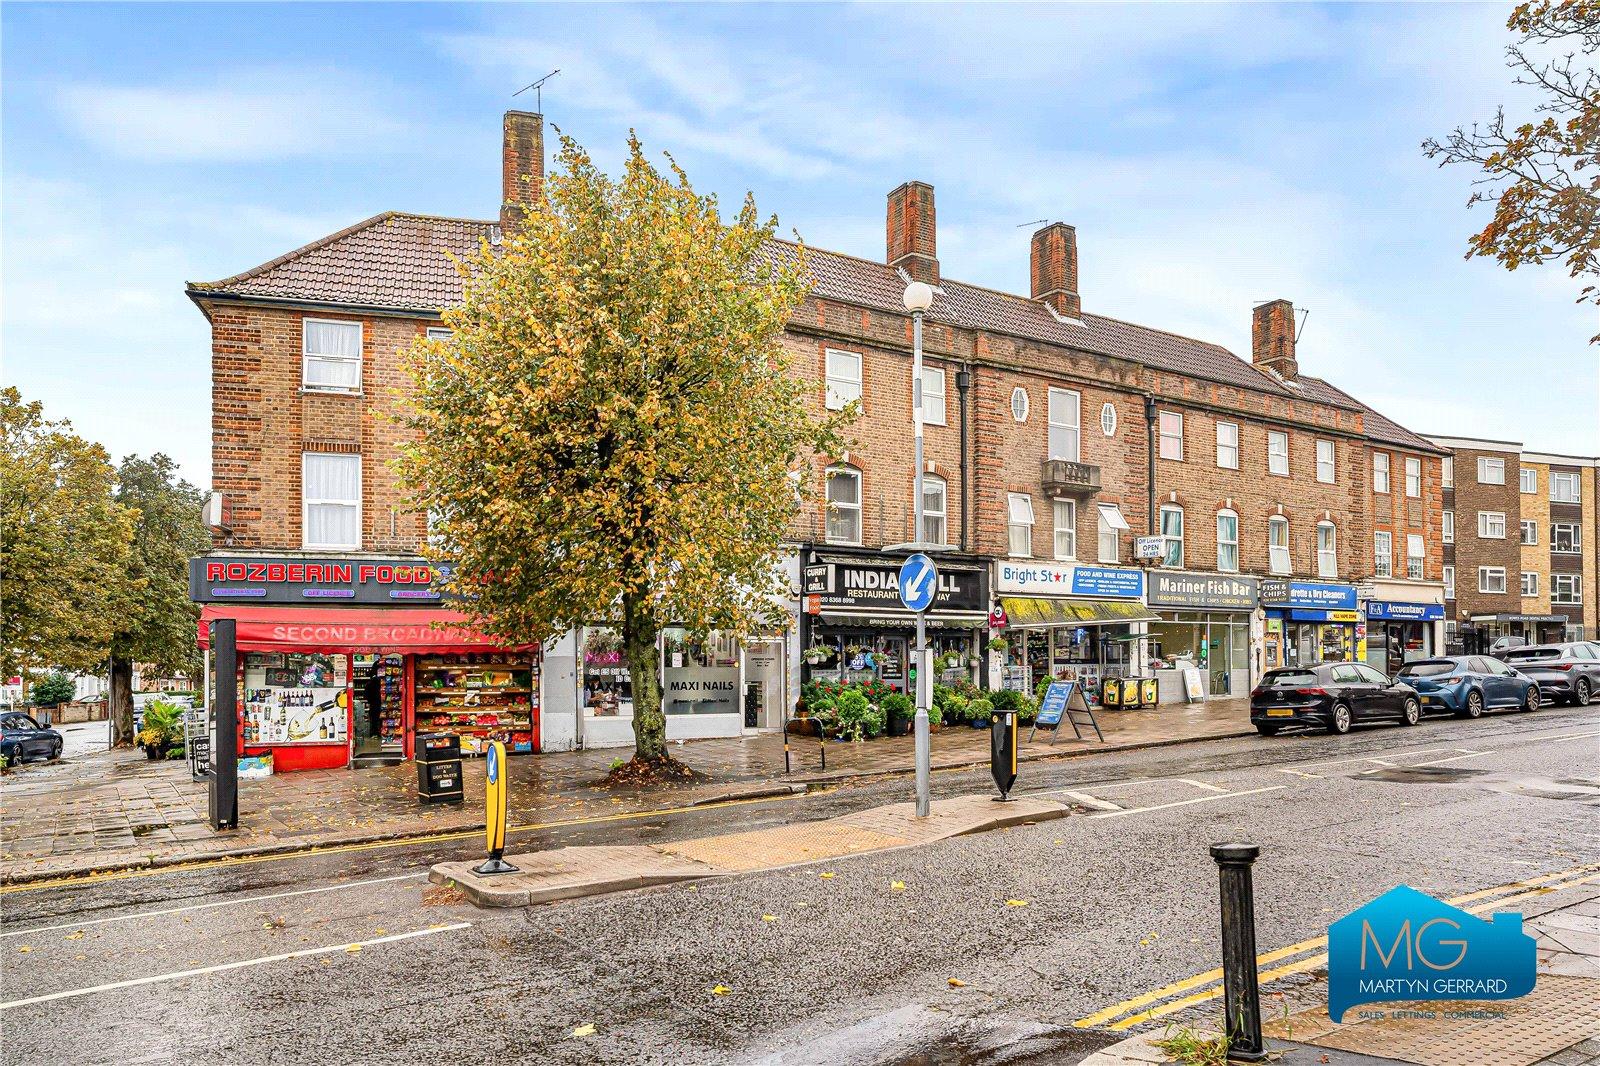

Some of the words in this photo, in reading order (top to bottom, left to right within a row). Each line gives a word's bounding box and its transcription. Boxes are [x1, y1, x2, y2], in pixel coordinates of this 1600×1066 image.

[206, 562, 352, 583] ROZBERIN
[359, 564, 432, 584] FOOD
[806, 567, 827, 577] CURRY
[1003, 567, 1037, 584] Bright
[808, 582, 825, 591] GRILL
[1159, 577, 1205, 594] Mariner
[1207, 580, 1230, 595] Fish
[1232, 581, 1251, 596] Bar
[847, 589, 899, 599] RESTAURANT
[1263, 590, 1287, 598] CHIPS
[1312, 589, 1323, 599] Dry
[1387, 603, 1426, 616] Accountancy
[273, 626, 357, 642] SECOND
[670, 681, 699, 691] MAXI
[702, 681, 734, 691] NAILS
[197, 760, 209, 769] he
